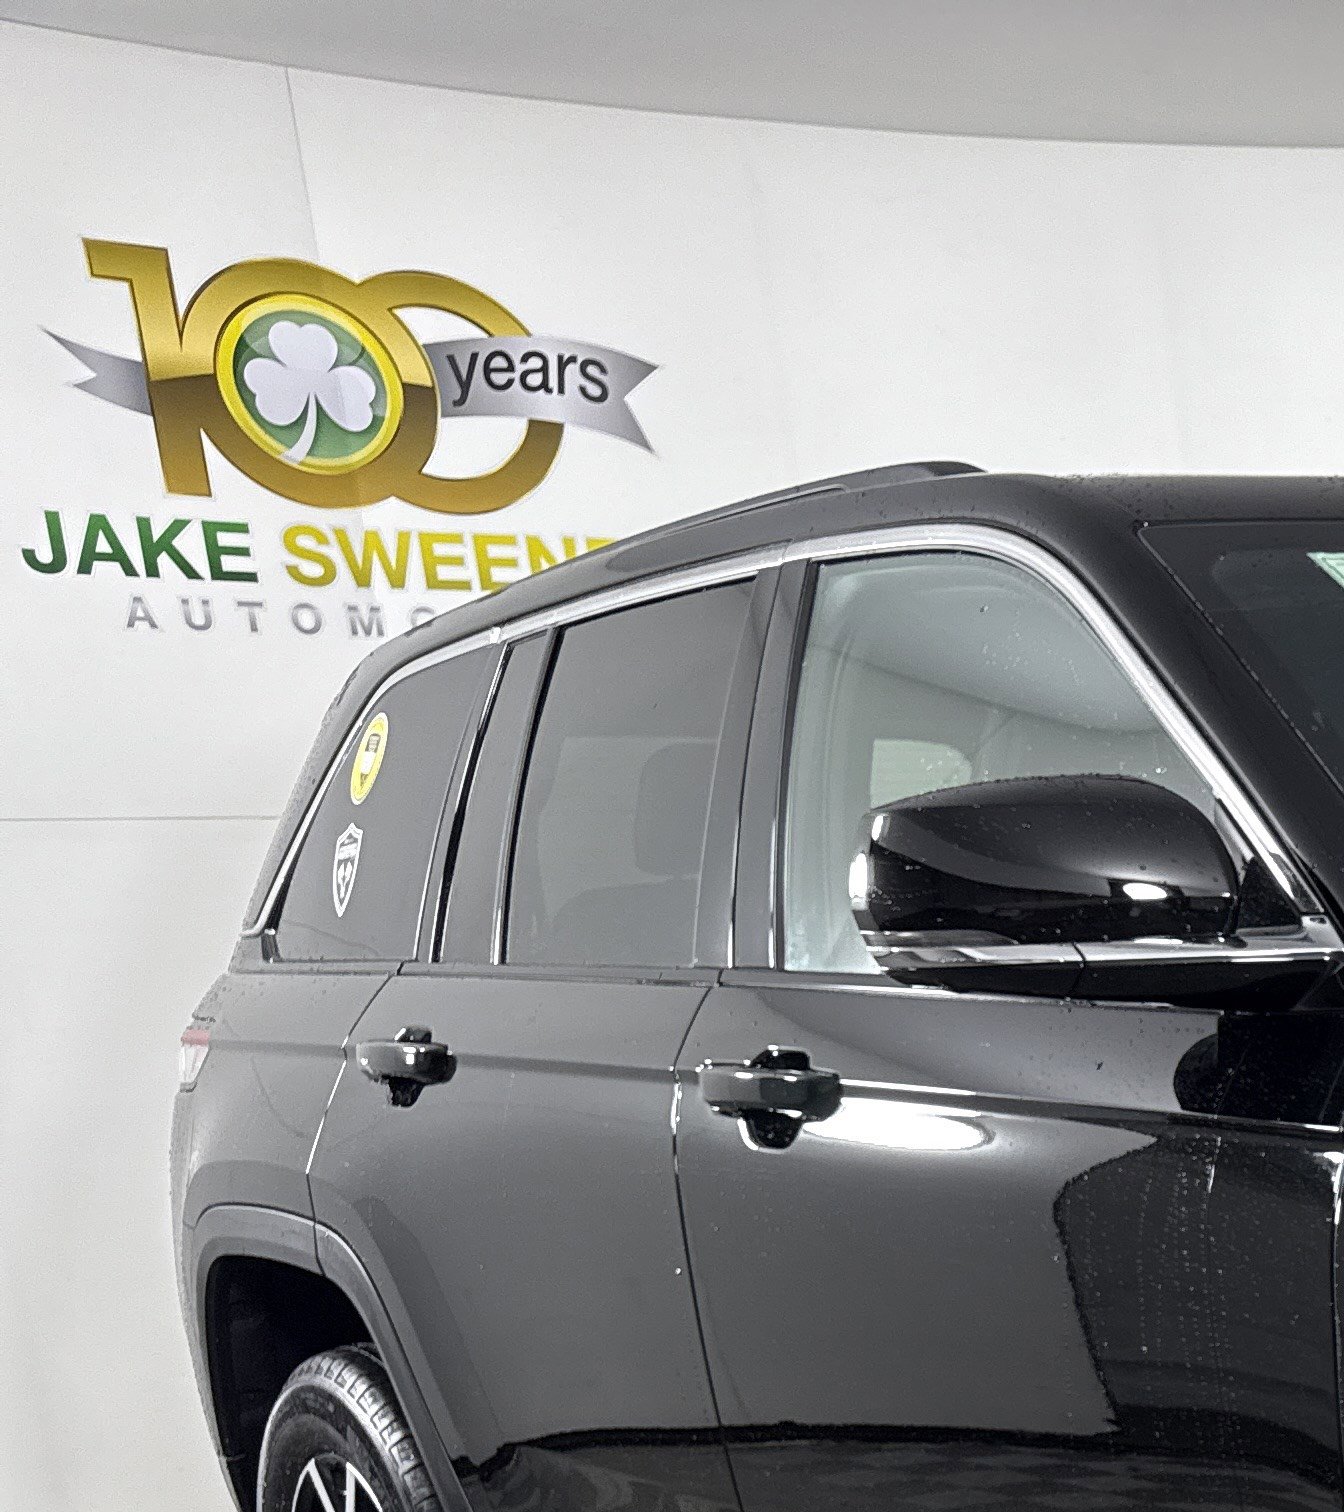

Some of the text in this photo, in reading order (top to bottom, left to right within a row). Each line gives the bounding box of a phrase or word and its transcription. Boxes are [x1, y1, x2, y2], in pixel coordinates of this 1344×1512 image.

[81, 236, 610, 515] 100 years
[21, 510, 259, 583] JAKE
